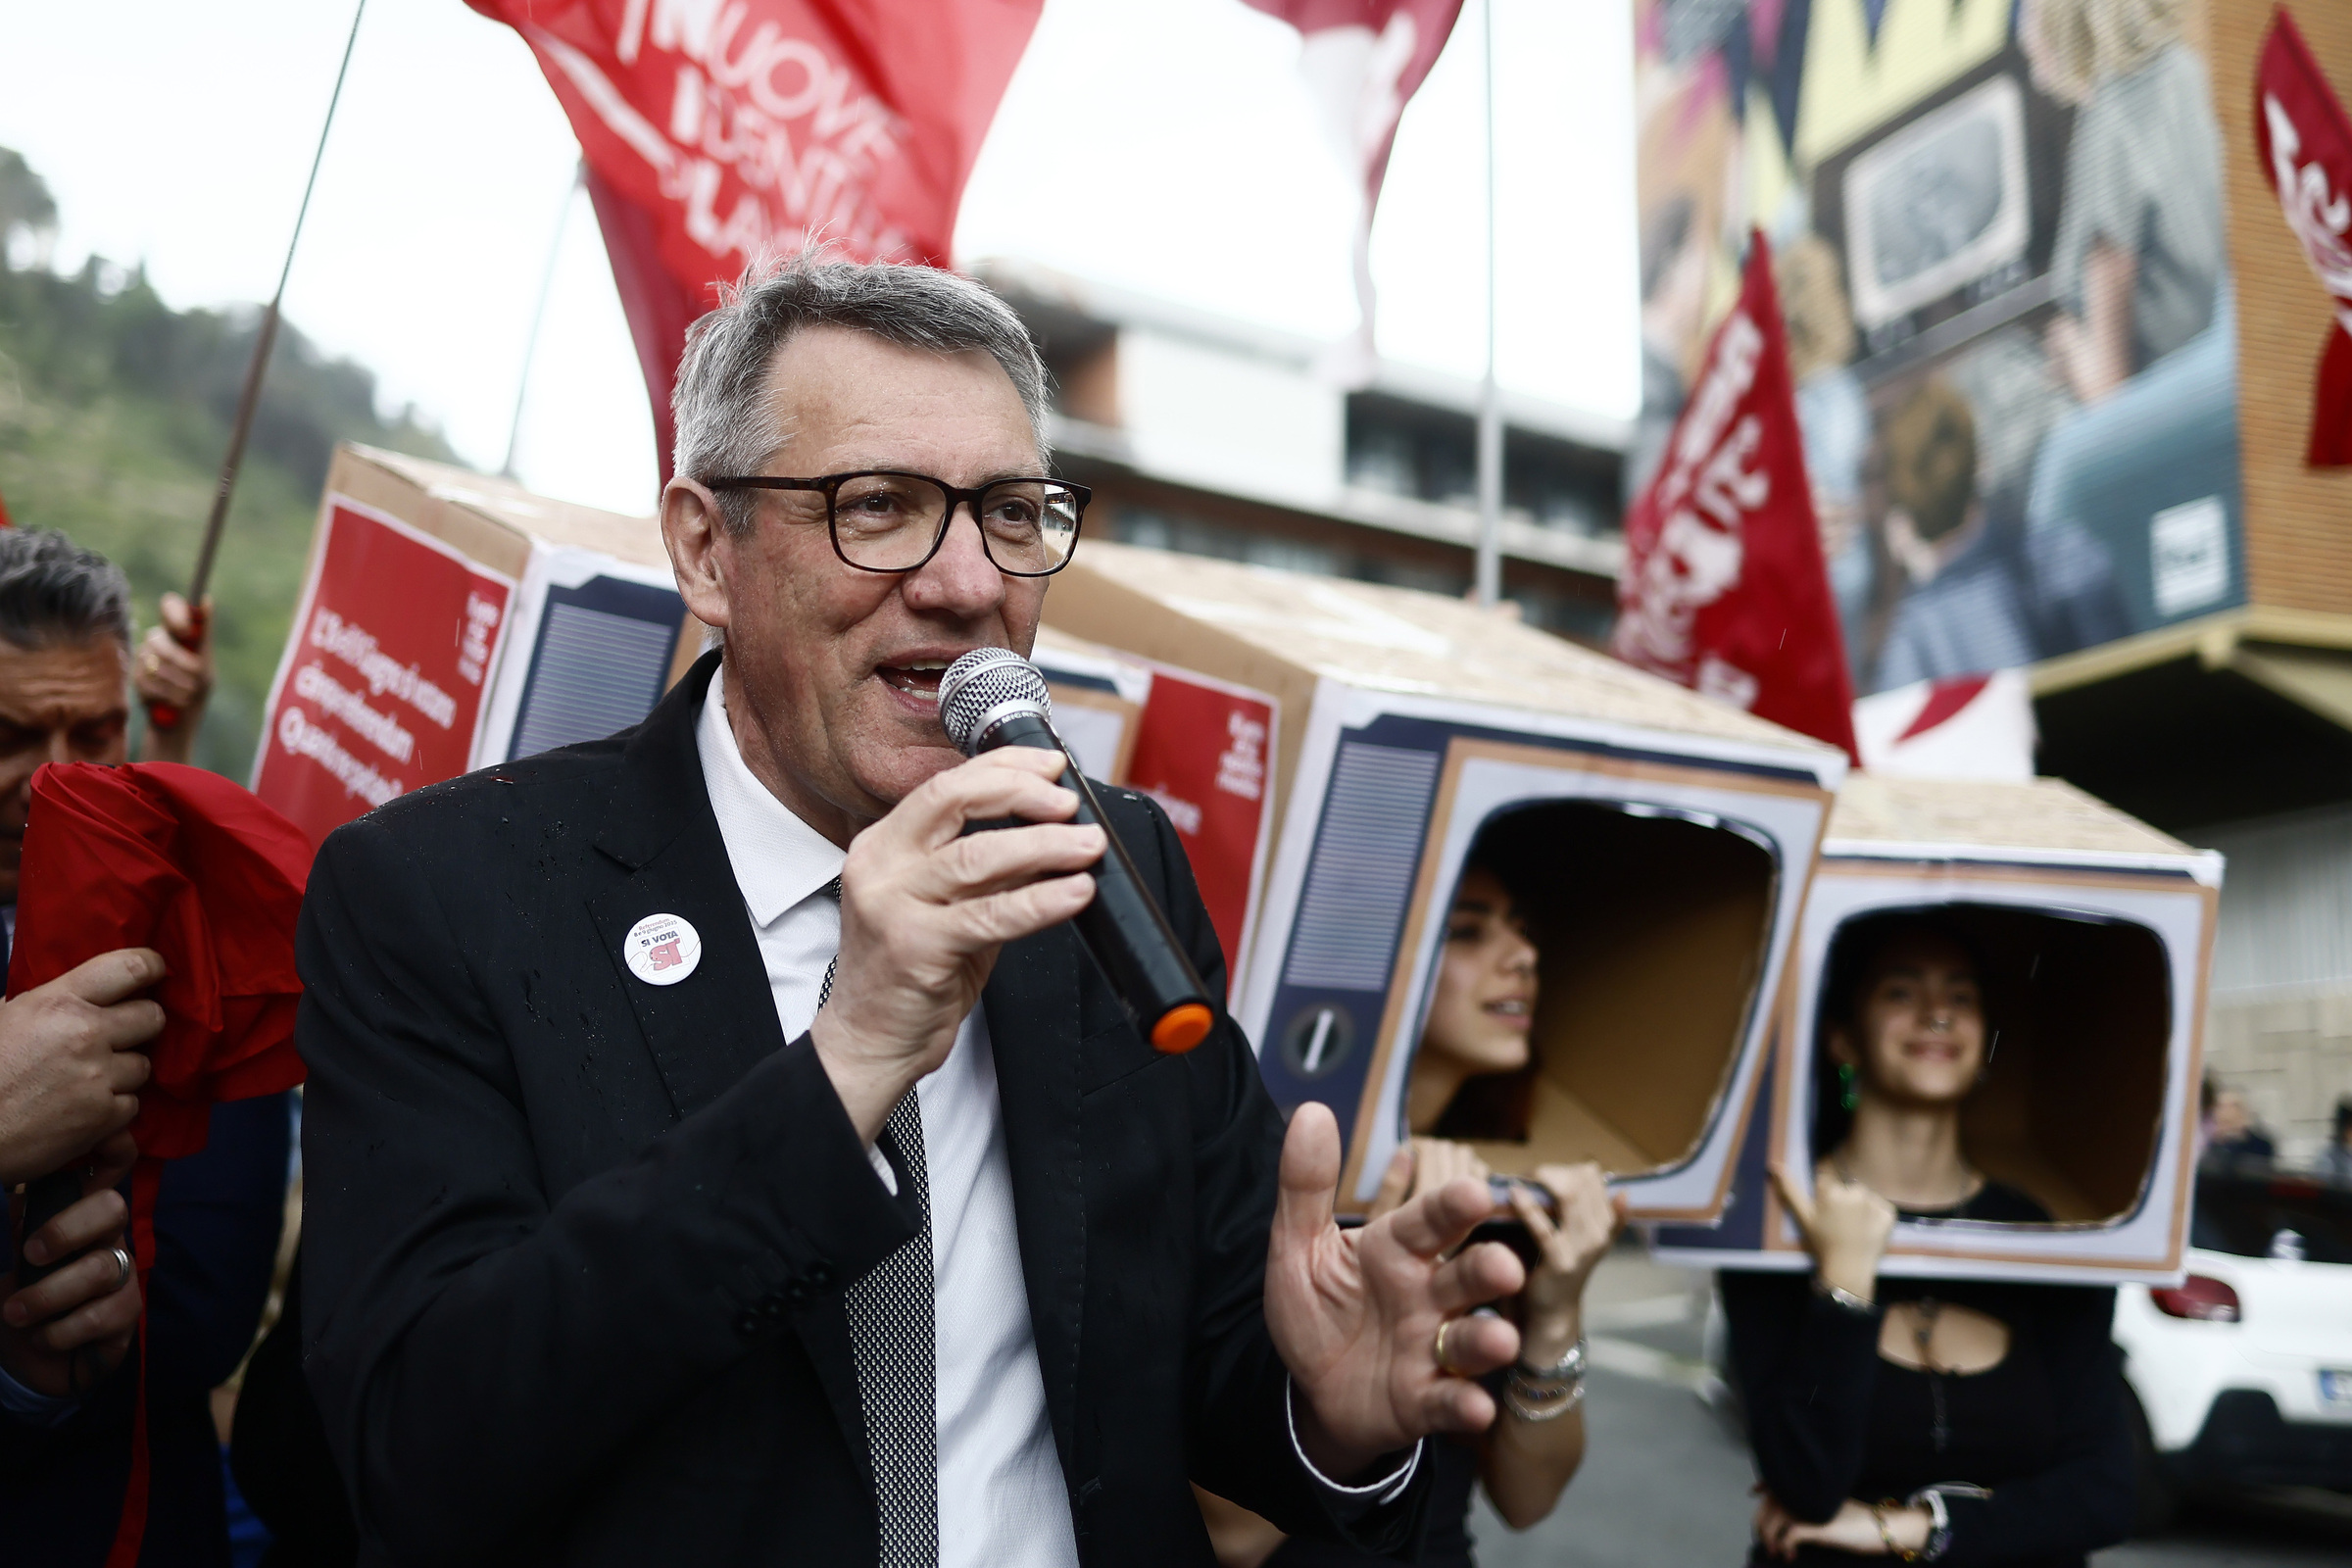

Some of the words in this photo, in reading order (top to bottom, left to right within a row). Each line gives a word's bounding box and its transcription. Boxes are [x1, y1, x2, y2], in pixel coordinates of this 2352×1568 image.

[639, 918, 669, 930] Referendum
[647, 924, 664, 934] giugno
[641, 939, 651, 947] SI
[652, 930, 678, 943] VOTA
